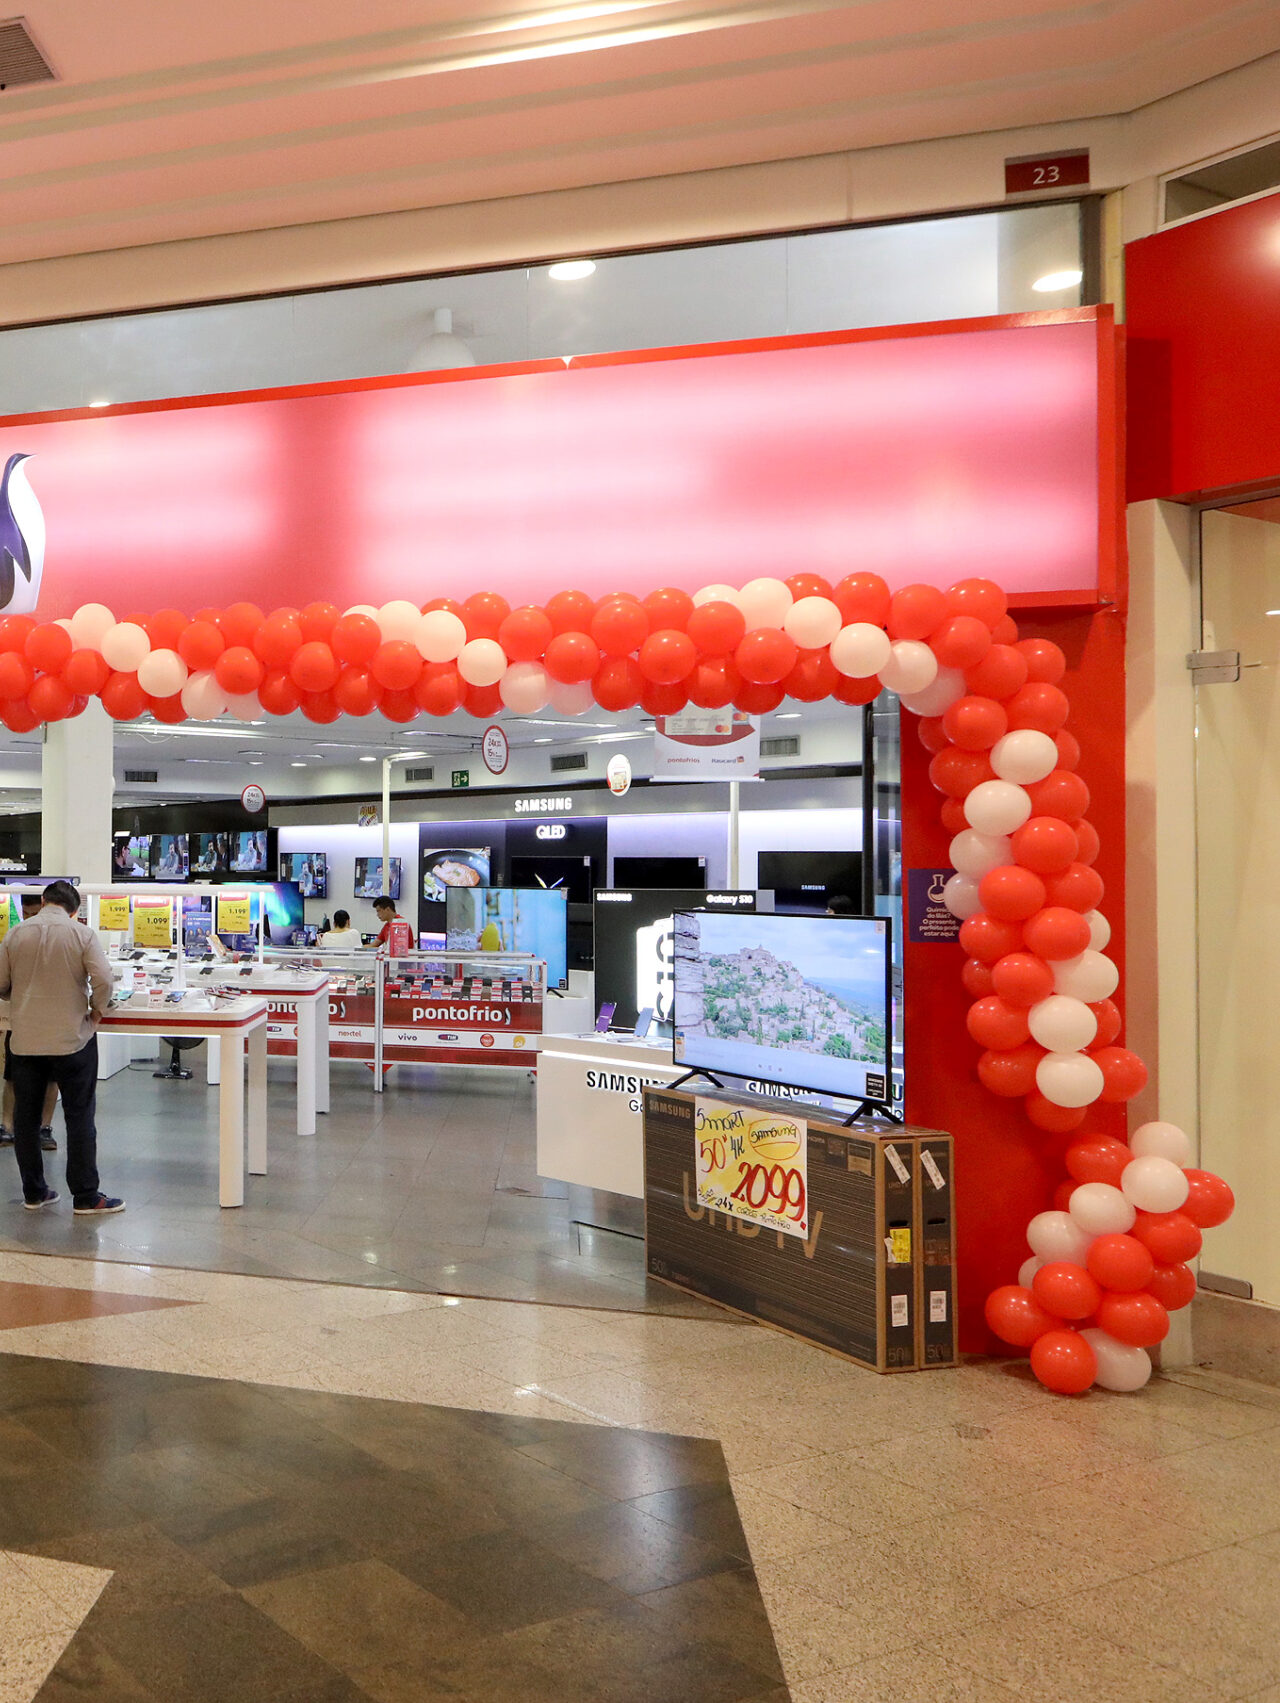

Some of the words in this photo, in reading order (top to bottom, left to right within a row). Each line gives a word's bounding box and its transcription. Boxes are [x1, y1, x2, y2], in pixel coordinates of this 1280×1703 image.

[1033, 166, 1060, 185] 23
[515, 797, 572, 812] SAMSUNG
[536, 824, 566, 839] QLED
[597, 893, 632, 902] SAMSUNG
[706, 894, 737, 906] Galaxy
[739, 895, 753, 903] S10
[147, 917, 167, 925] 1.099
[412, 1005, 503, 1022] pontofrio
[398, 1033, 417, 1041] vivo
[586, 1071, 665, 1095] SAMS
[748, 1082, 812, 1097] SAMS
[649, 1099, 692, 1119] SAMSUNG
